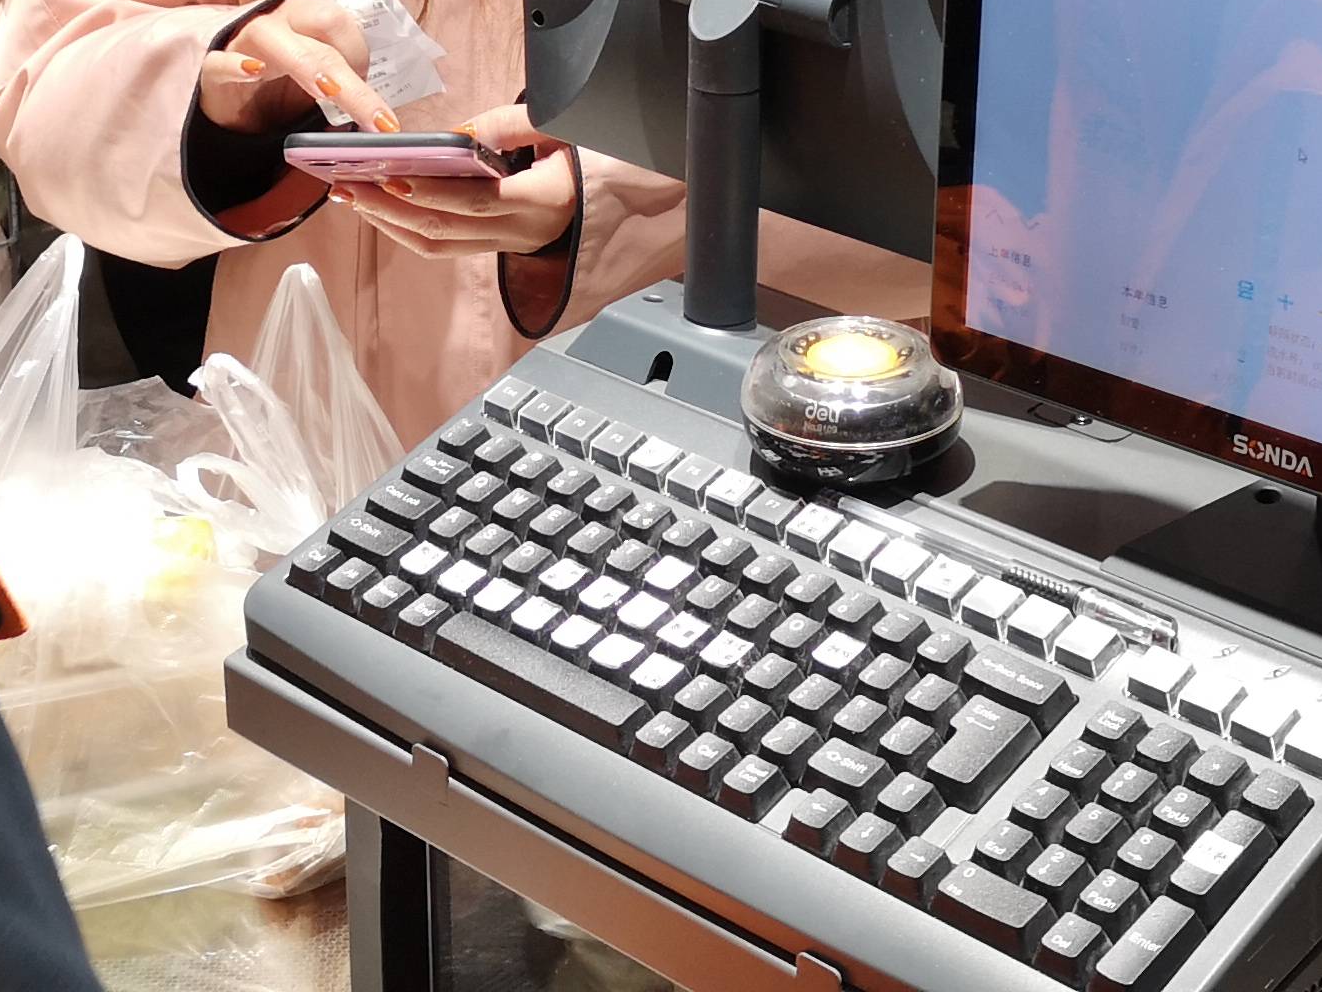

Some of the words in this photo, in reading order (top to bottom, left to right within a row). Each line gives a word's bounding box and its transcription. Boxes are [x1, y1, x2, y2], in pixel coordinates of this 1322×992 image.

[1232, 434, 1314, 478] SONDA
[511, 492, 528, 506] W
[547, 509, 563, 521] E
[360, 522, 382, 538] Shift
[483, 528, 498, 540] S
[585, 527, 600, 539] R
[705, 581, 720, 593] U
[976, 703, 1001, 722] Enter
[1073, 745, 1087, 756] 7
[840, 756, 868, 775] Shift
[1123, 769, 1137, 781] 8
[1174, 792, 1188, 803] 9
[1160, 805, 1190, 823] PgUp
[1140, 834, 1154, 845] 6
[984, 840, 1007, 856] End
[1050, 851, 1066, 863] 2
[962, 867, 977, 878] 0
[1102, 875, 1117, 888] 3
[1087, 890, 1117, 909] PgDn
[1050, 934, 1072, 950] Del
[1128, 931, 1161, 953] Enter
